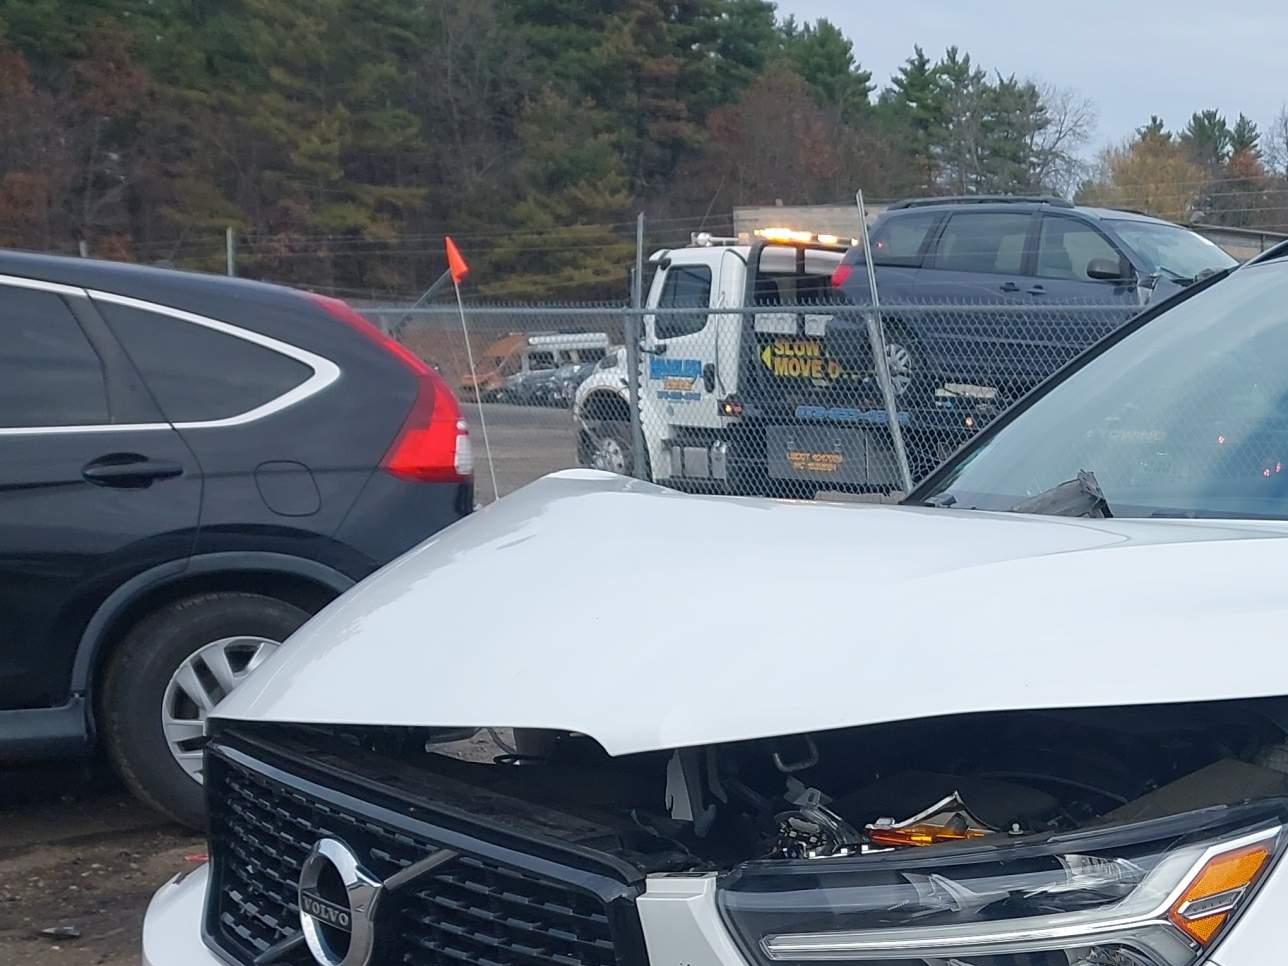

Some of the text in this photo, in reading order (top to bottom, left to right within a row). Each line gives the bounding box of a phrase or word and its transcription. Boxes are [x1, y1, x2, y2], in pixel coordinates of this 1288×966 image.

[774, 337, 820, 357] SLOW
[774, 356, 823, 378] MOVE
[304, 896, 349, 926] VOLVO
